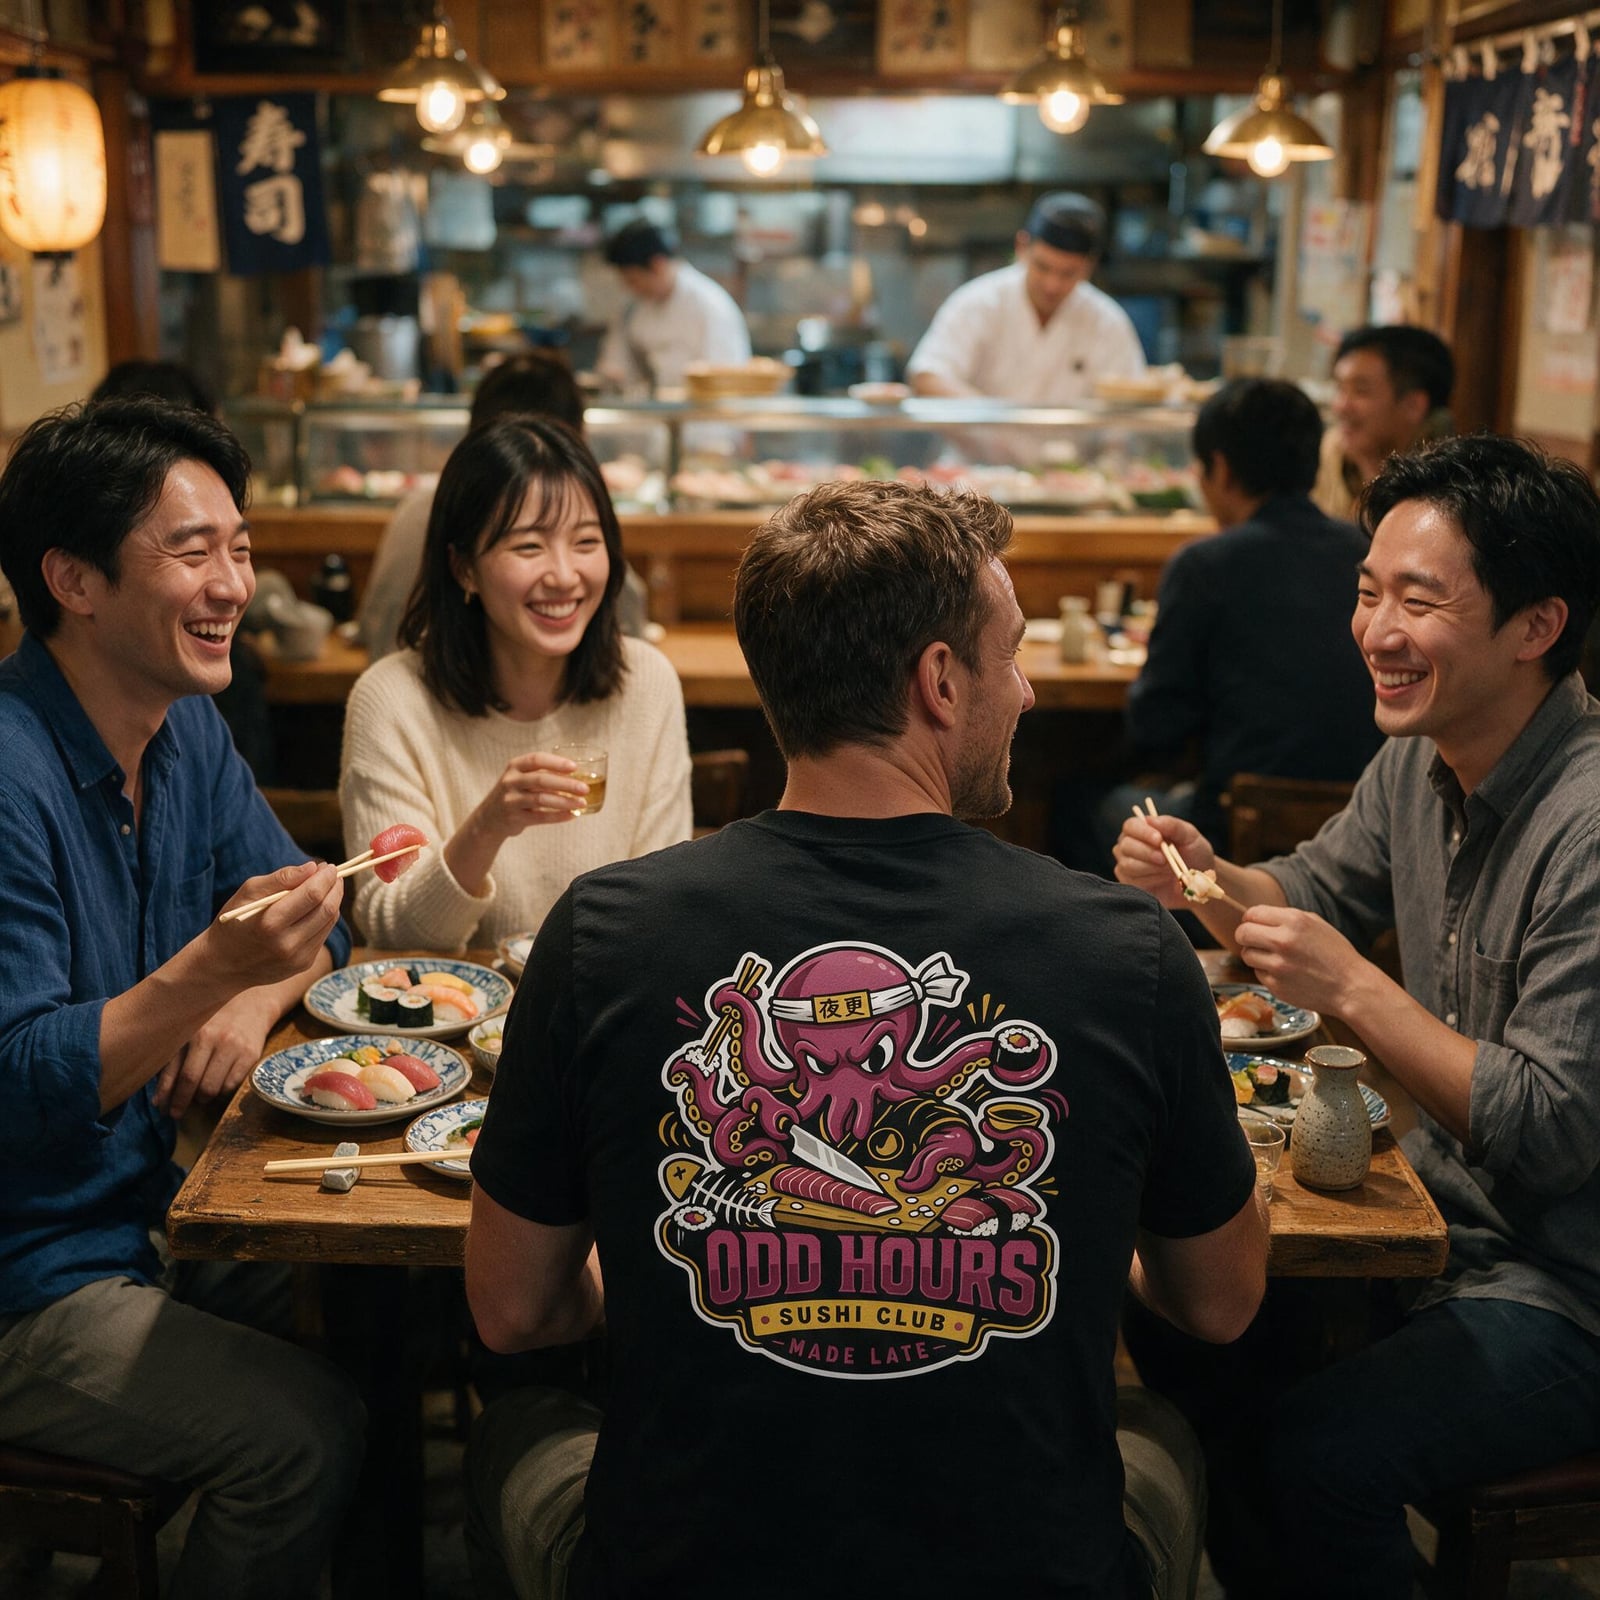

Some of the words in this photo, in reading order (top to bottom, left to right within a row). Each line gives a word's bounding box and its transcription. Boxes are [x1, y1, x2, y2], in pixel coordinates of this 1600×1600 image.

[818, 996, 865, 1019] 夜更
[706, 1229, 822, 1306] ODD
[839, 1234, 1038, 1317] HOURS
[779, 1306, 861, 1326] SUSHI
[876, 1307, 946, 1331] CLUB
[788, 1338, 854, 1365] MADE
[870, 1342, 928, 1366] LATE
